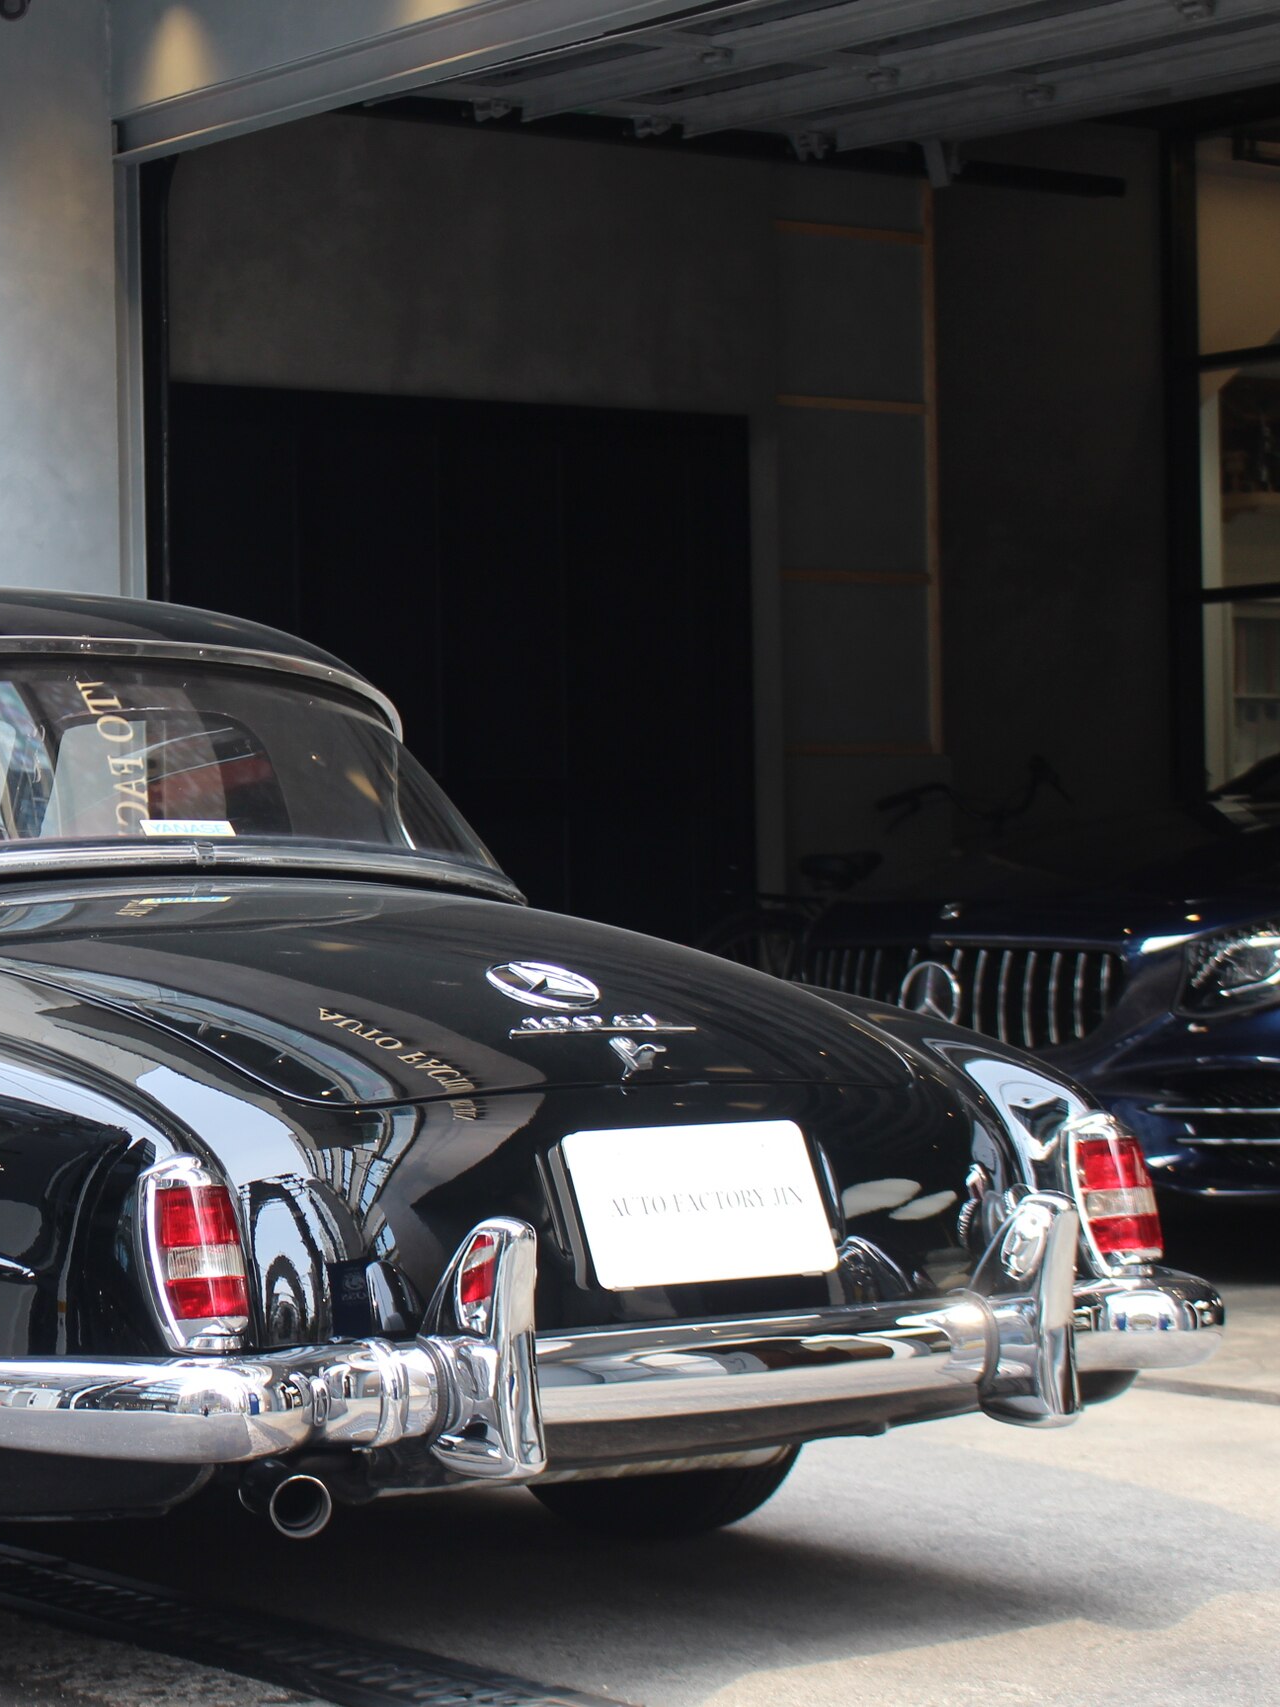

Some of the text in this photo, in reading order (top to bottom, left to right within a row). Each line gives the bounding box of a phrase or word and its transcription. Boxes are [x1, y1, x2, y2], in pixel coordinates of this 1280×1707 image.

[149, 822, 231, 835] YANASE
[610, 1185, 803, 1217] AUTO FACTORY JIN
